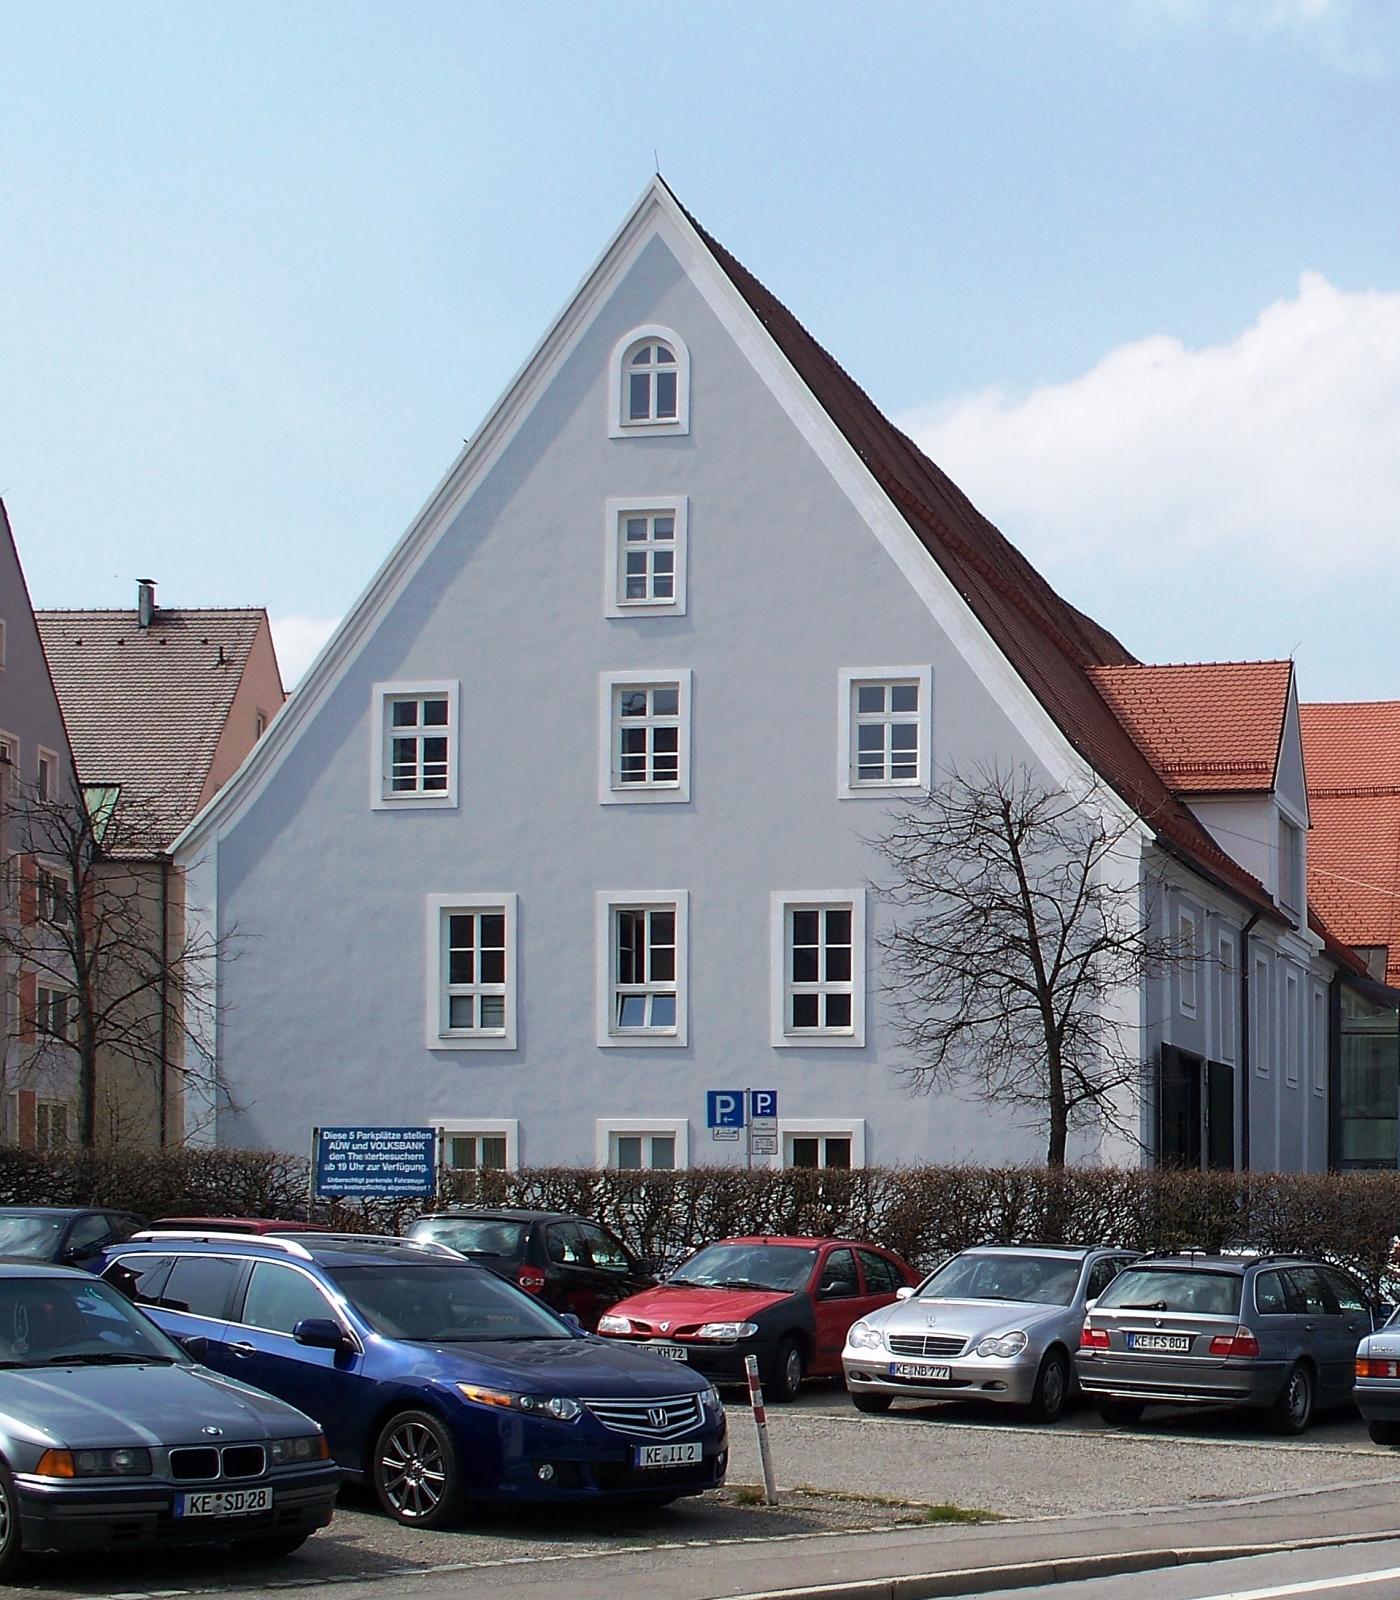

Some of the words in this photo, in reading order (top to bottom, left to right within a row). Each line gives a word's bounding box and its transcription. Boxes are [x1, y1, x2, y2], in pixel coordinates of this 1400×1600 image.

[715, 1095, 735, 1124] P
[757, 1093, 771, 1114] P
[323, 1131, 347, 1140] Diese
[349, 1131, 355, 1140] 5
[357, 1131, 401, 1141] Parkplätze
[403, 1131, 432, 1140] stellen
[329, 1140, 350, 1150] AÜW
[351, 1141, 368, 1150] und
[370, 1141, 425, 1150] VOLKSBANK
[329, 1152, 346, 1160] den
[324, 1162, 336, 1171] ab
[337, 1162, 347, 1171] 19
[349, 1162, 364, 1171] Uhr
[366, 1163, 381, 1171] zur
[382, 1162, 429, 1173] Verfügung.
[1135, 1335, 1148, 1347] KE
[1153, 1336, 1167, 1348] FS
[1168, 1337, 1188, 1349] 801
[671, 1348, 684, 1359] 72
[896, 1364, 909, 1375] KE
[914, 1365, 928, 1376] NB
[929, 1366, 948, 1378] 777
[646, 1447, 662, 1464] KE
[669, 1446, 683, 1462] II
[687, 1445, 694, 1461] 2
[189, 1495, 212, 1514] KE
